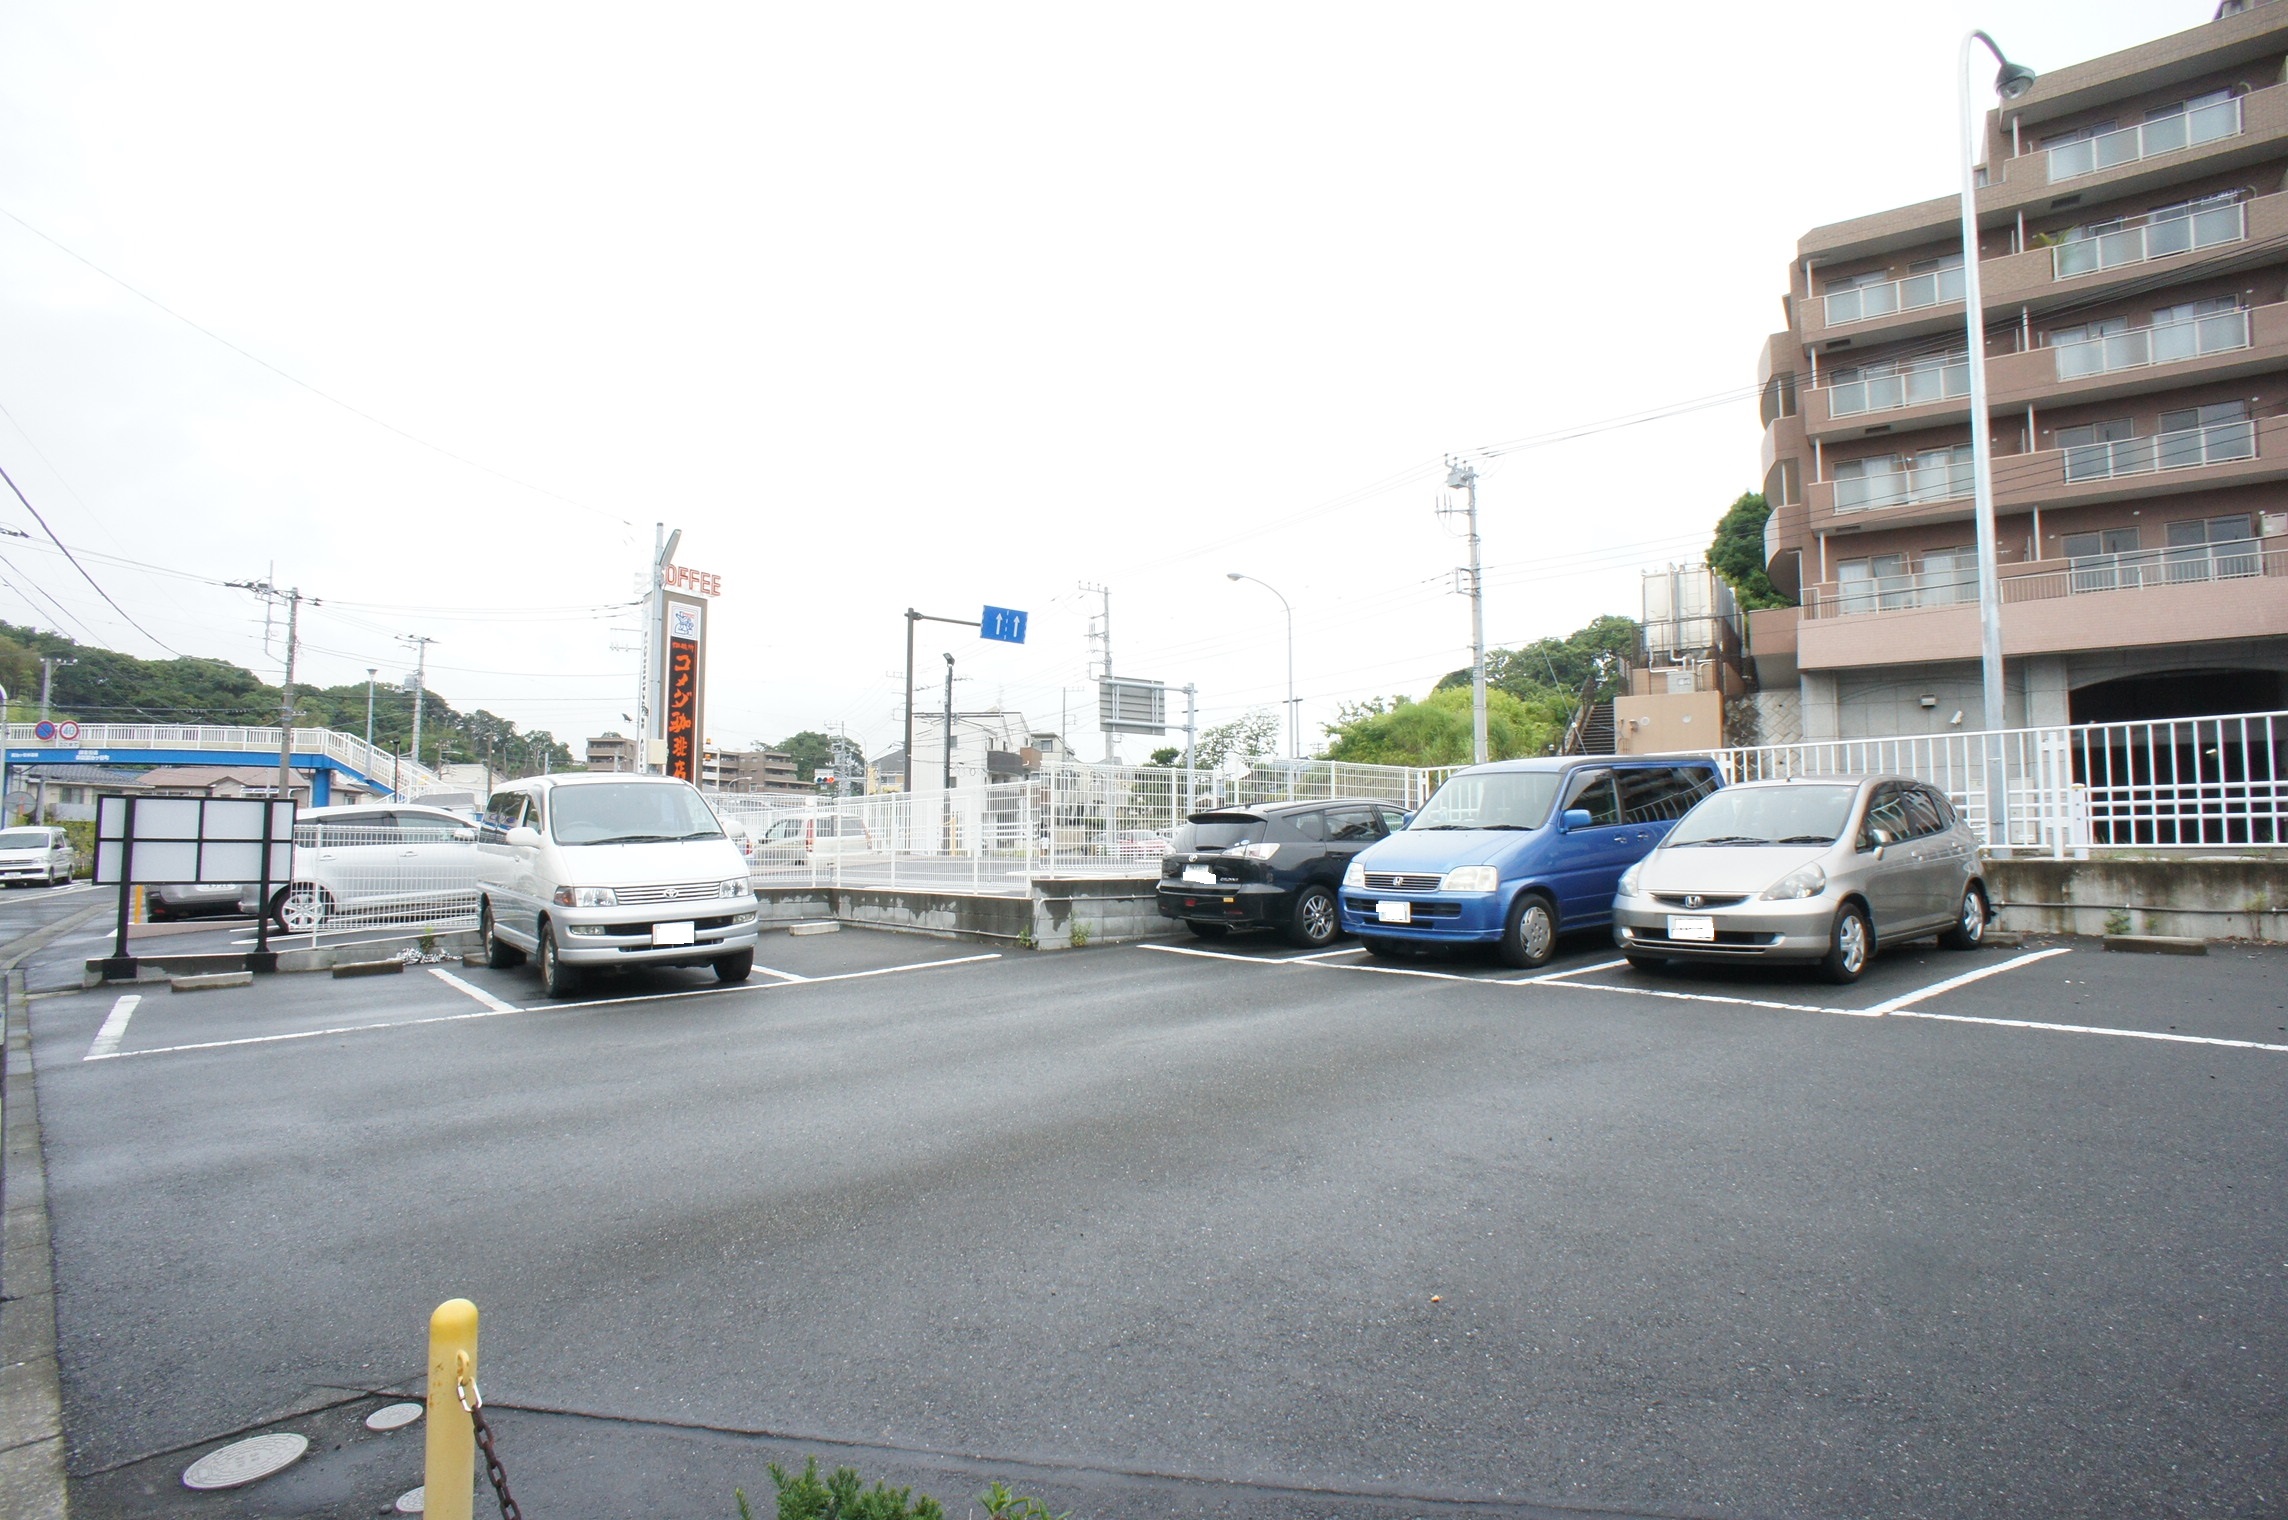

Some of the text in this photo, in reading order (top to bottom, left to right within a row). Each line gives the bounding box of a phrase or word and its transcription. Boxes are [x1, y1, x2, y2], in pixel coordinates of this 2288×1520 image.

[663, 563, 721, 597] OFFEE
[63, 725, 76, 736] 40
[668, 653, 692, 781] コメダ珈琲店
